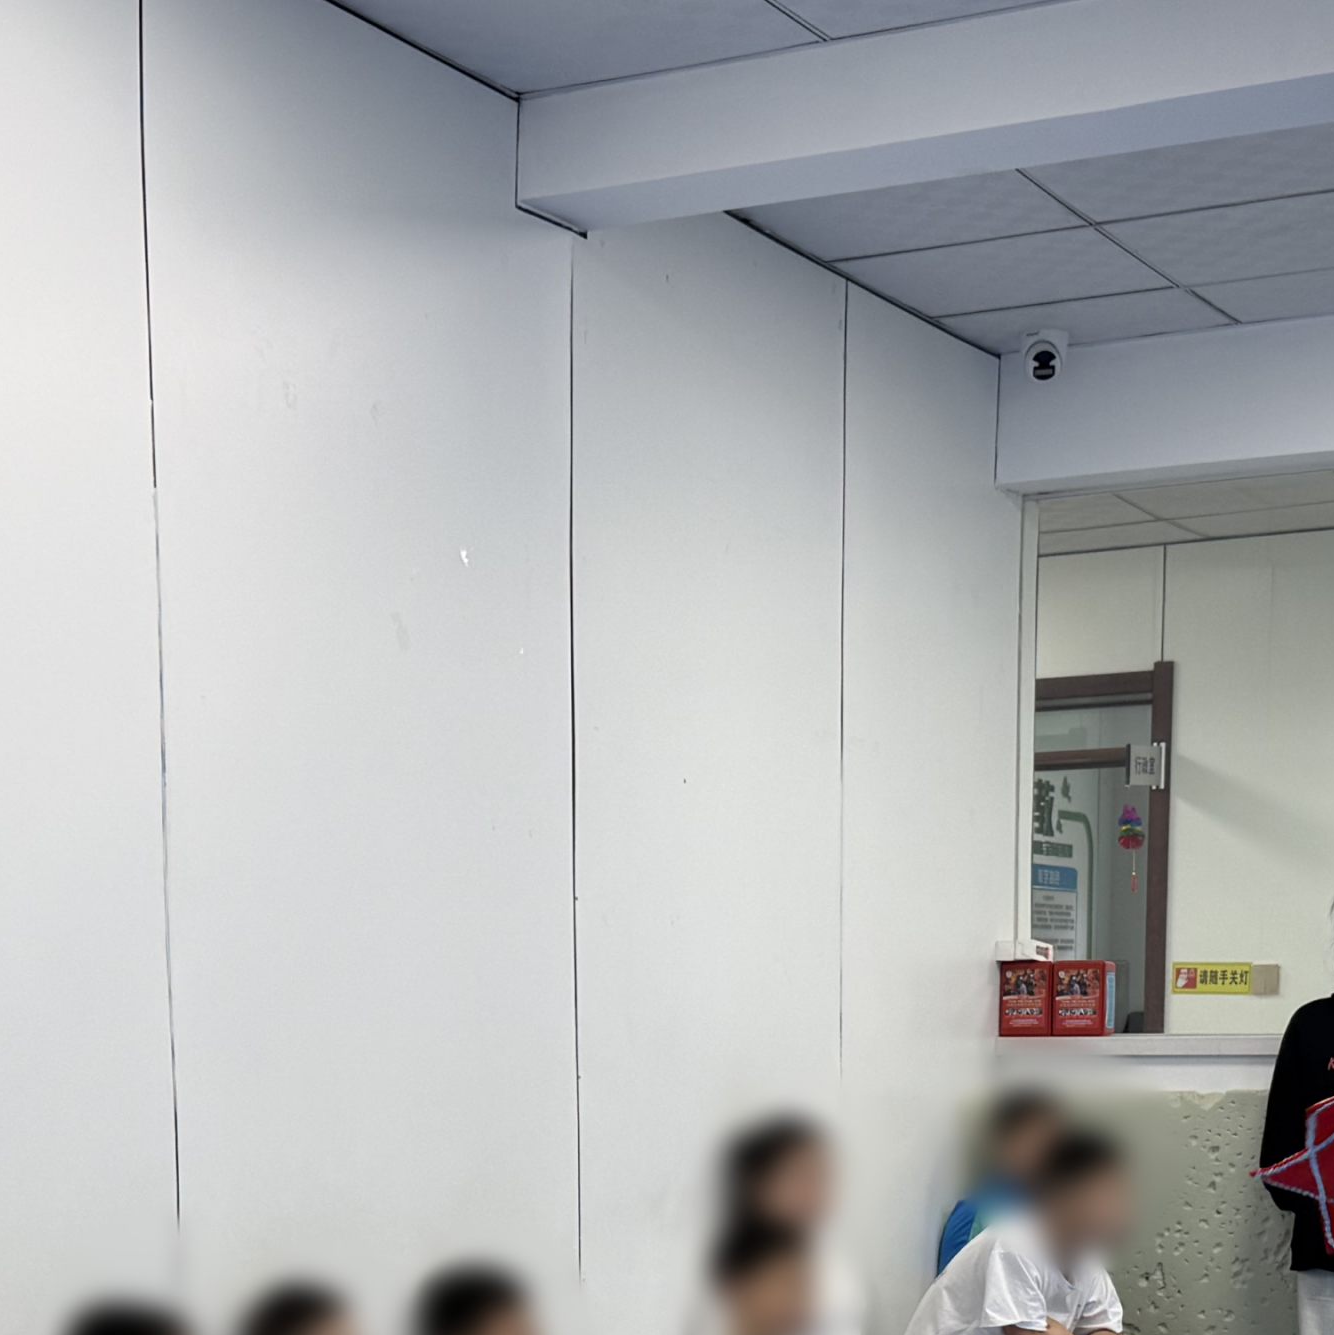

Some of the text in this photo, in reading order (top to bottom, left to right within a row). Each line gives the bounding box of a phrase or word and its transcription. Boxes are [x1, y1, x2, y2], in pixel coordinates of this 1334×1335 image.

[1199, 969, 1249, 985] 请随手关灯
